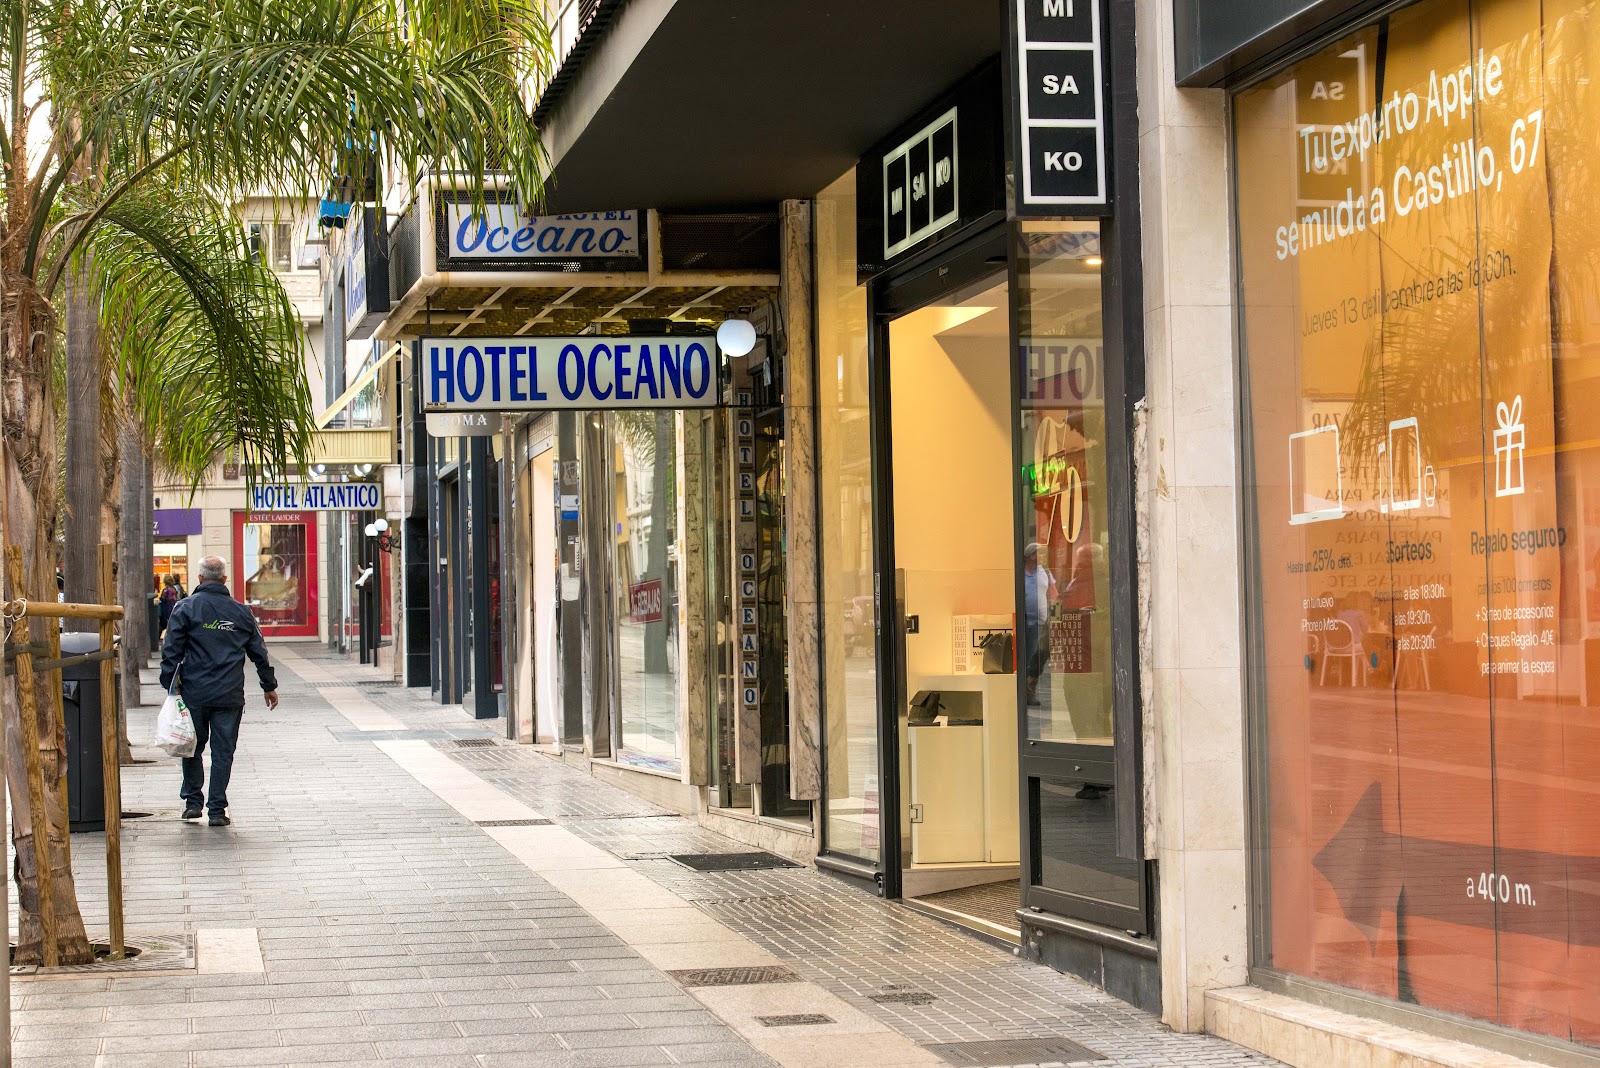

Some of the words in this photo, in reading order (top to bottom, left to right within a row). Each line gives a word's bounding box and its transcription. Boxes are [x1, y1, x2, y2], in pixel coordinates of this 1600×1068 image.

[1042, 0, 1074, 17] MI
[1042, 74, 1080, 95] SA
[1300, 126, 1327, 173] Tu
[1330, 90, 1419, 162] experto
[1425, 48, 1503, 126] Apple
[1043, 151, 1083, 172] KO
[891, 186, 903, 216] MI
[912, 171, 927, 201] SA
[935, 155, 951, 188] KO
[1275, 221, 1299, 261] se
[1301, 186, 1366, 251] muda
[1369, 186, 1386, 226] a
[1392, 138, 1503, 217] Castillo,
[1509, 108, 1543, 175] 67
[1302, 307, 1339, 338] Jueves
[1340, 297, 1359, 325] 13
[1436, 276, 1444, 299] a
[430, 345, 548, 403] HOTEL
[557, 342, 711, 400] OCEANO
[738, 393, 753, 516] HOTEL
[254, 485, 298, 509] HOTEL
[303, 485, 379, 508] ATLANTICO
[1470, 528, 1509, 559] Regalo
[1286, 560, 1304, 574] Hasta
[1312, 548, 1337, 573] 25%
[1502, 576, 1517, 593] 100
[1323, 617, 1339, 631] Mac
[1502, 604, 1512, 621] de
[1513, 602, 1554, 620] accesorios
[742, 554, 756, 704] OCEANO
[1511, 630, 1539, 650] Regalo
[1497, 658, 1520, 674] animar
[1521, 658, 1529, 674] la
[1530, 660, 1555, 678] espera
[1466, 877, 1475, 898] a
[1477, 872, 1510, 904] 400
[1514, 882, 1537, 907] m.
